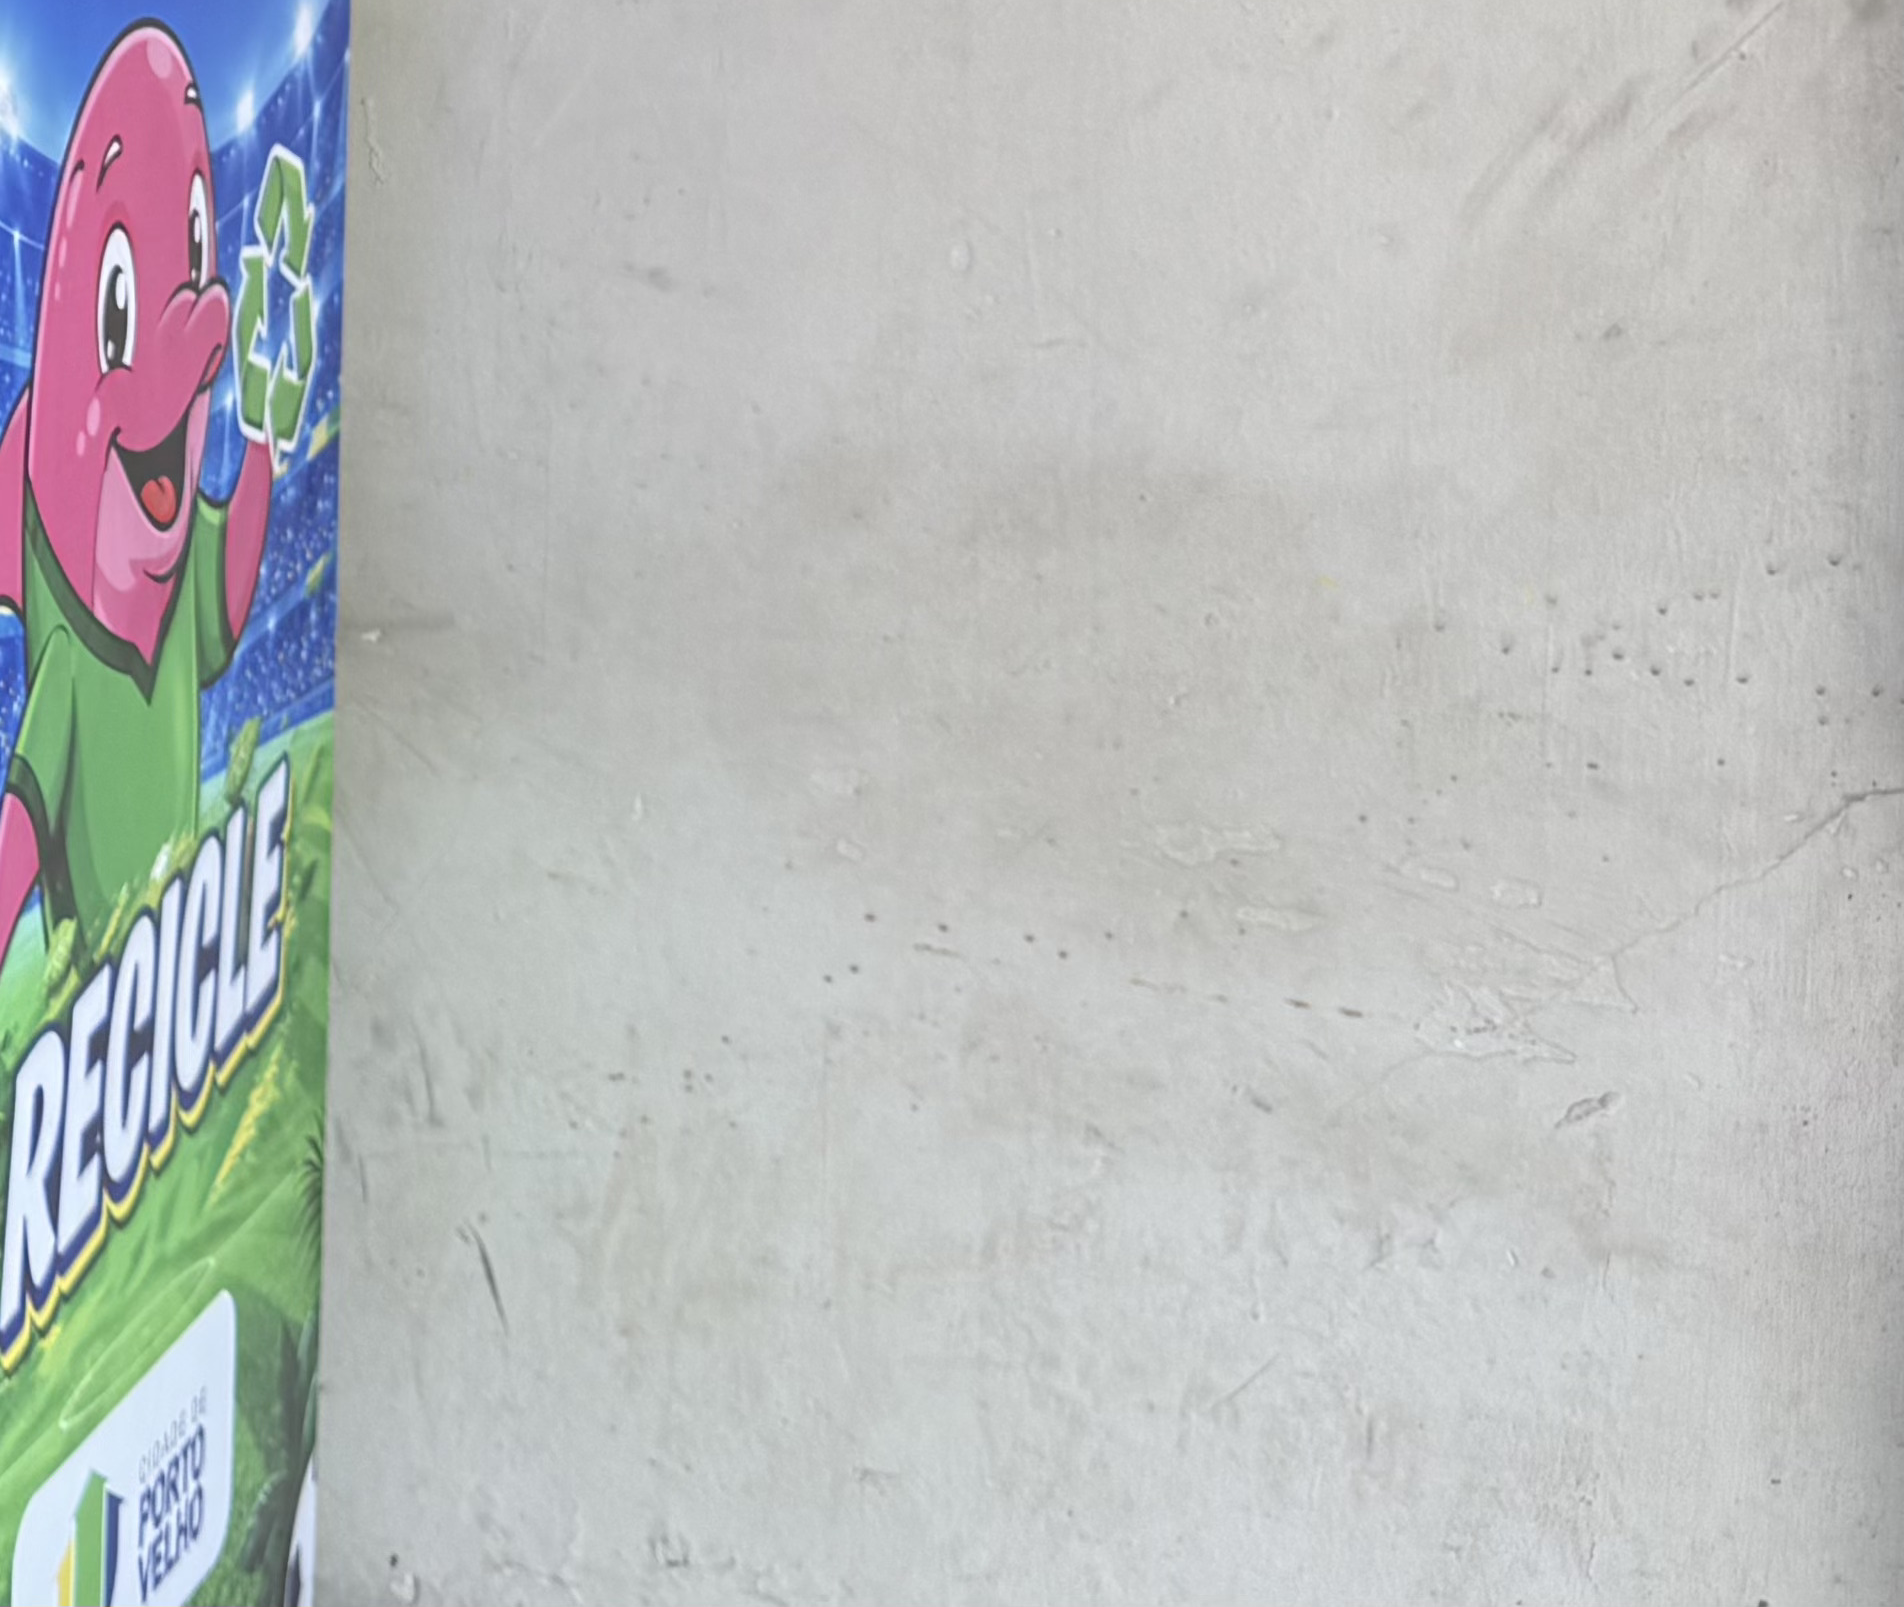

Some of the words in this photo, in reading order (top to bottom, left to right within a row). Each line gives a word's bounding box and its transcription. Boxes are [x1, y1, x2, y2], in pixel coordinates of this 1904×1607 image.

[139, 1410, 187, 1483] CIDADE
[139, 1423, 206, 1549] PORTO
[138, 1483, 203, 1603] VELHO
